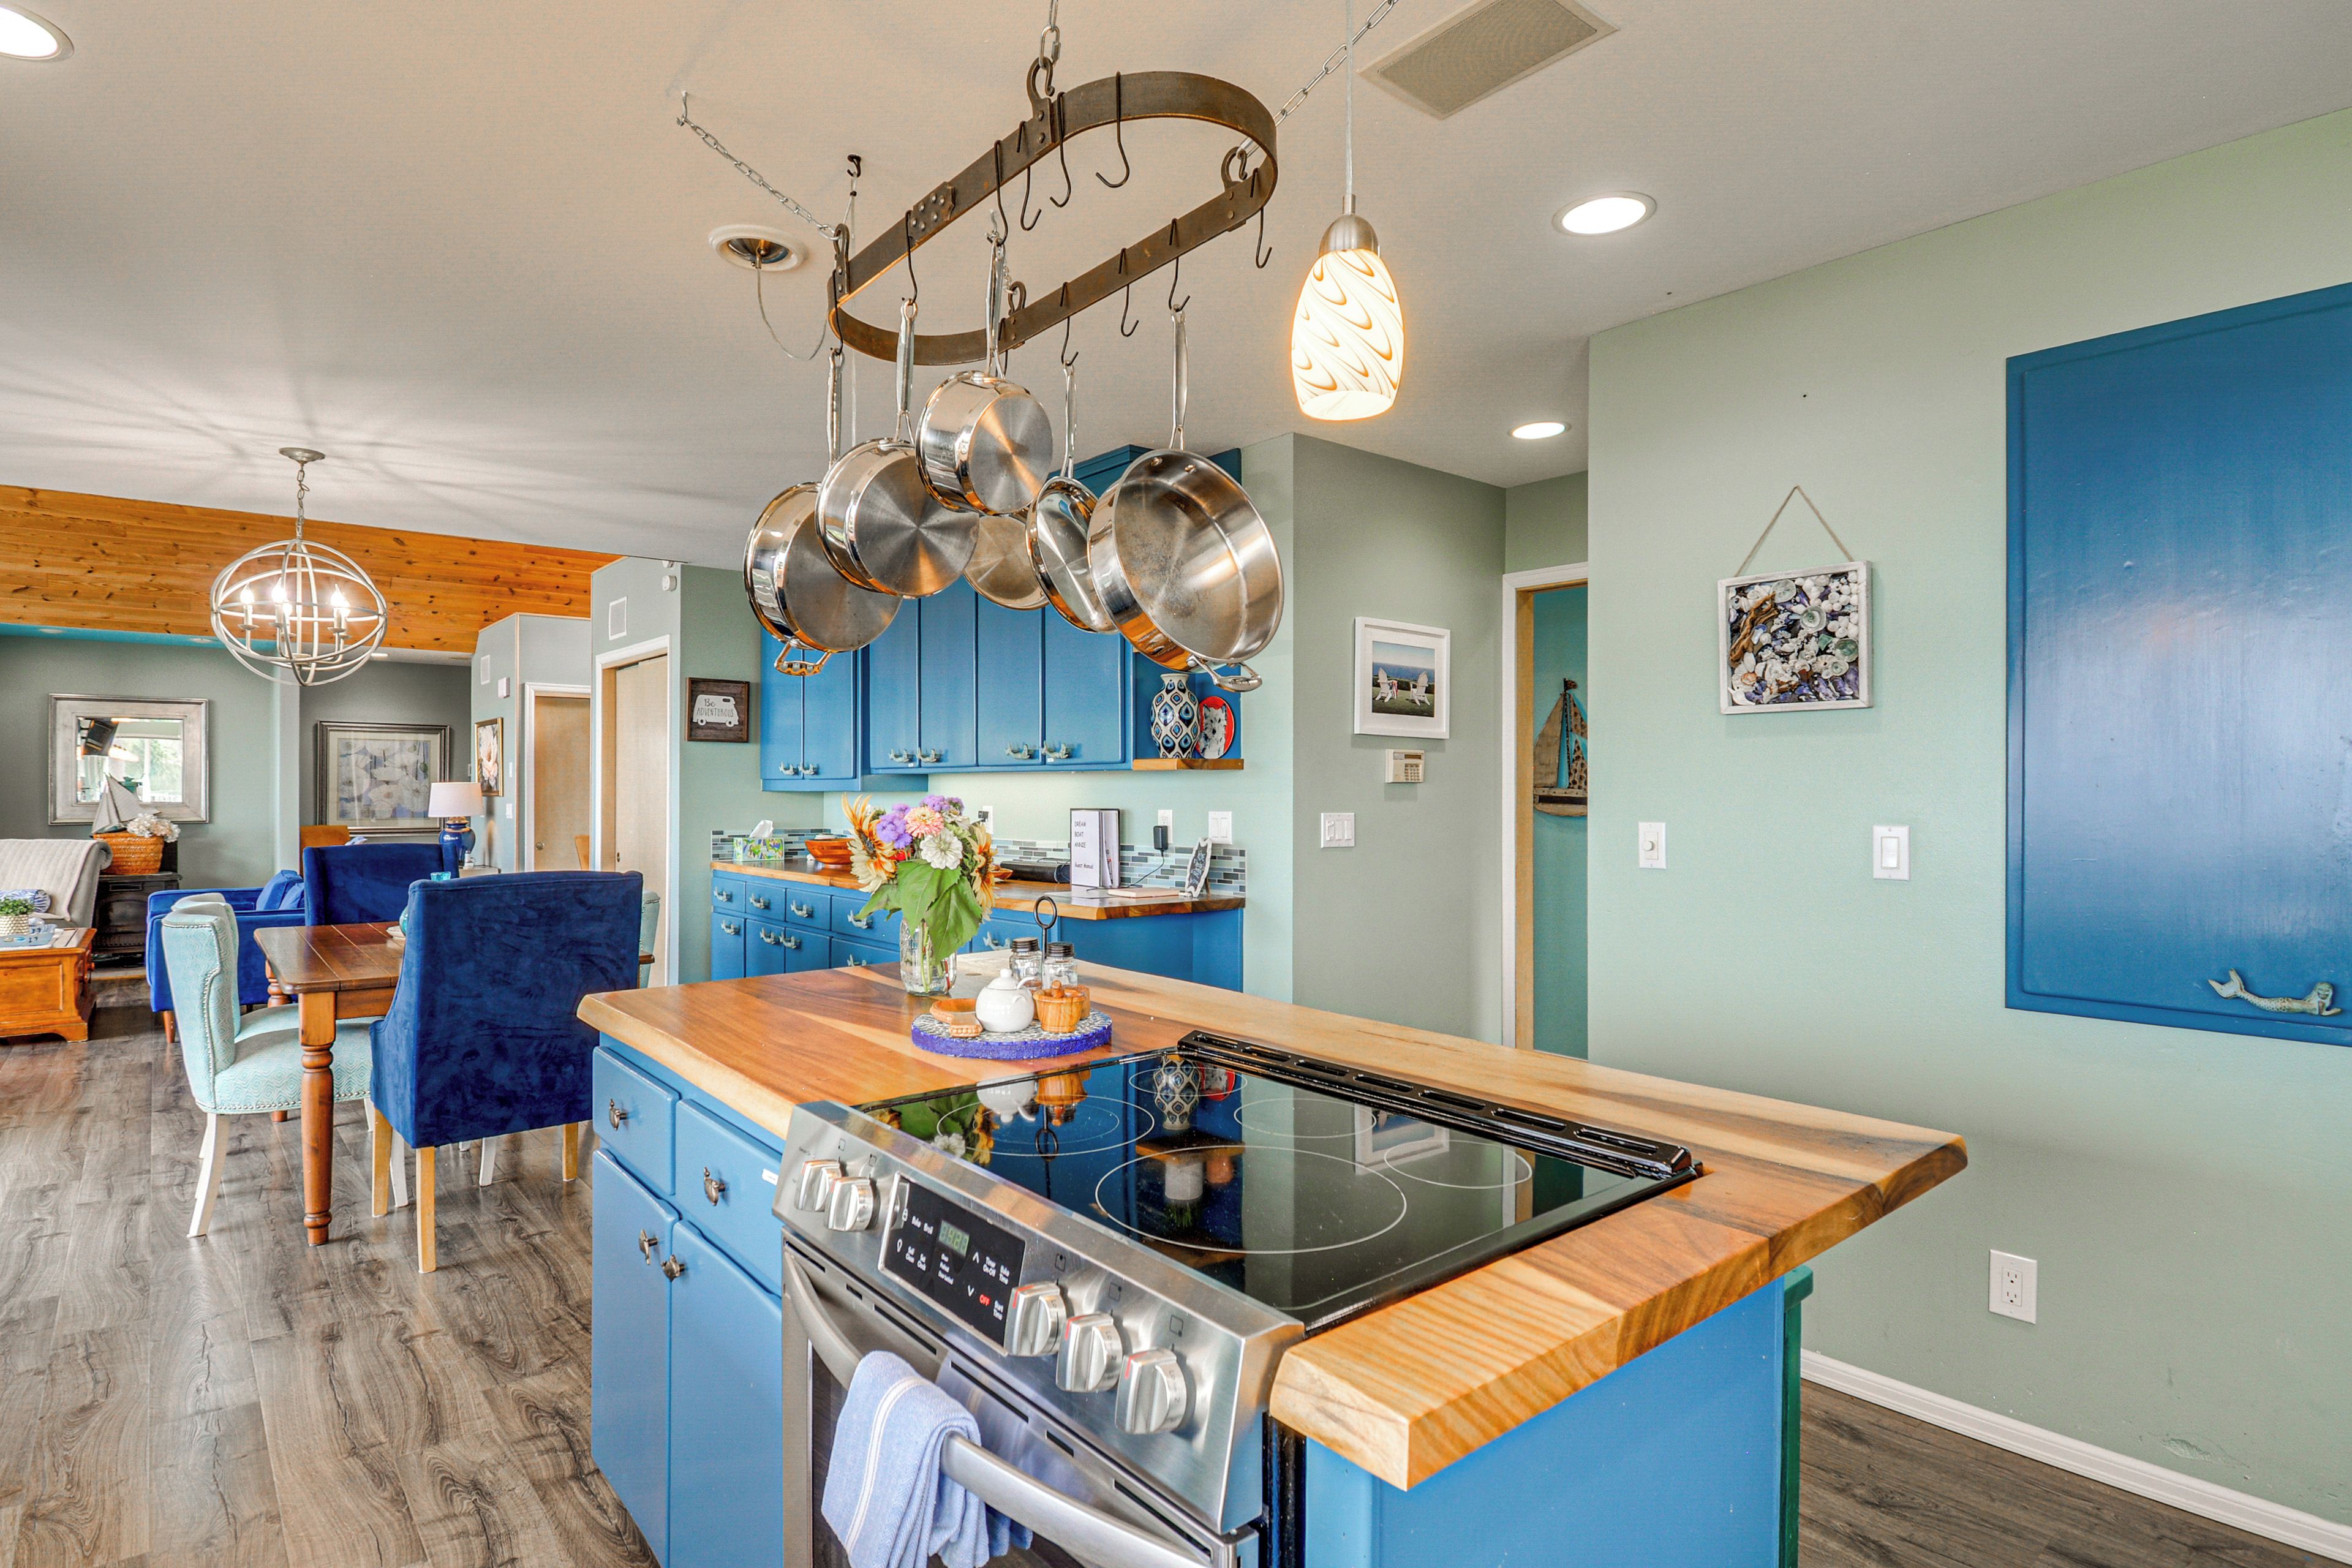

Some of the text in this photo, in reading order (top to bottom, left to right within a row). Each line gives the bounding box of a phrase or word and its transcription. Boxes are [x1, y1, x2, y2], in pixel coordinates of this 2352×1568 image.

[704, 698, 715, 707] Be
[696, 707, 734, 717] ADVENTUROUS
[911, 1216, 933, 1235] Bake Broil
[986, 1256, 996, 1268] Timer
[999, 1273, 1009, 1285] Time
[979, 1294, 990, 1306] OFF
[993, 1308, 1003, 1321] Time
